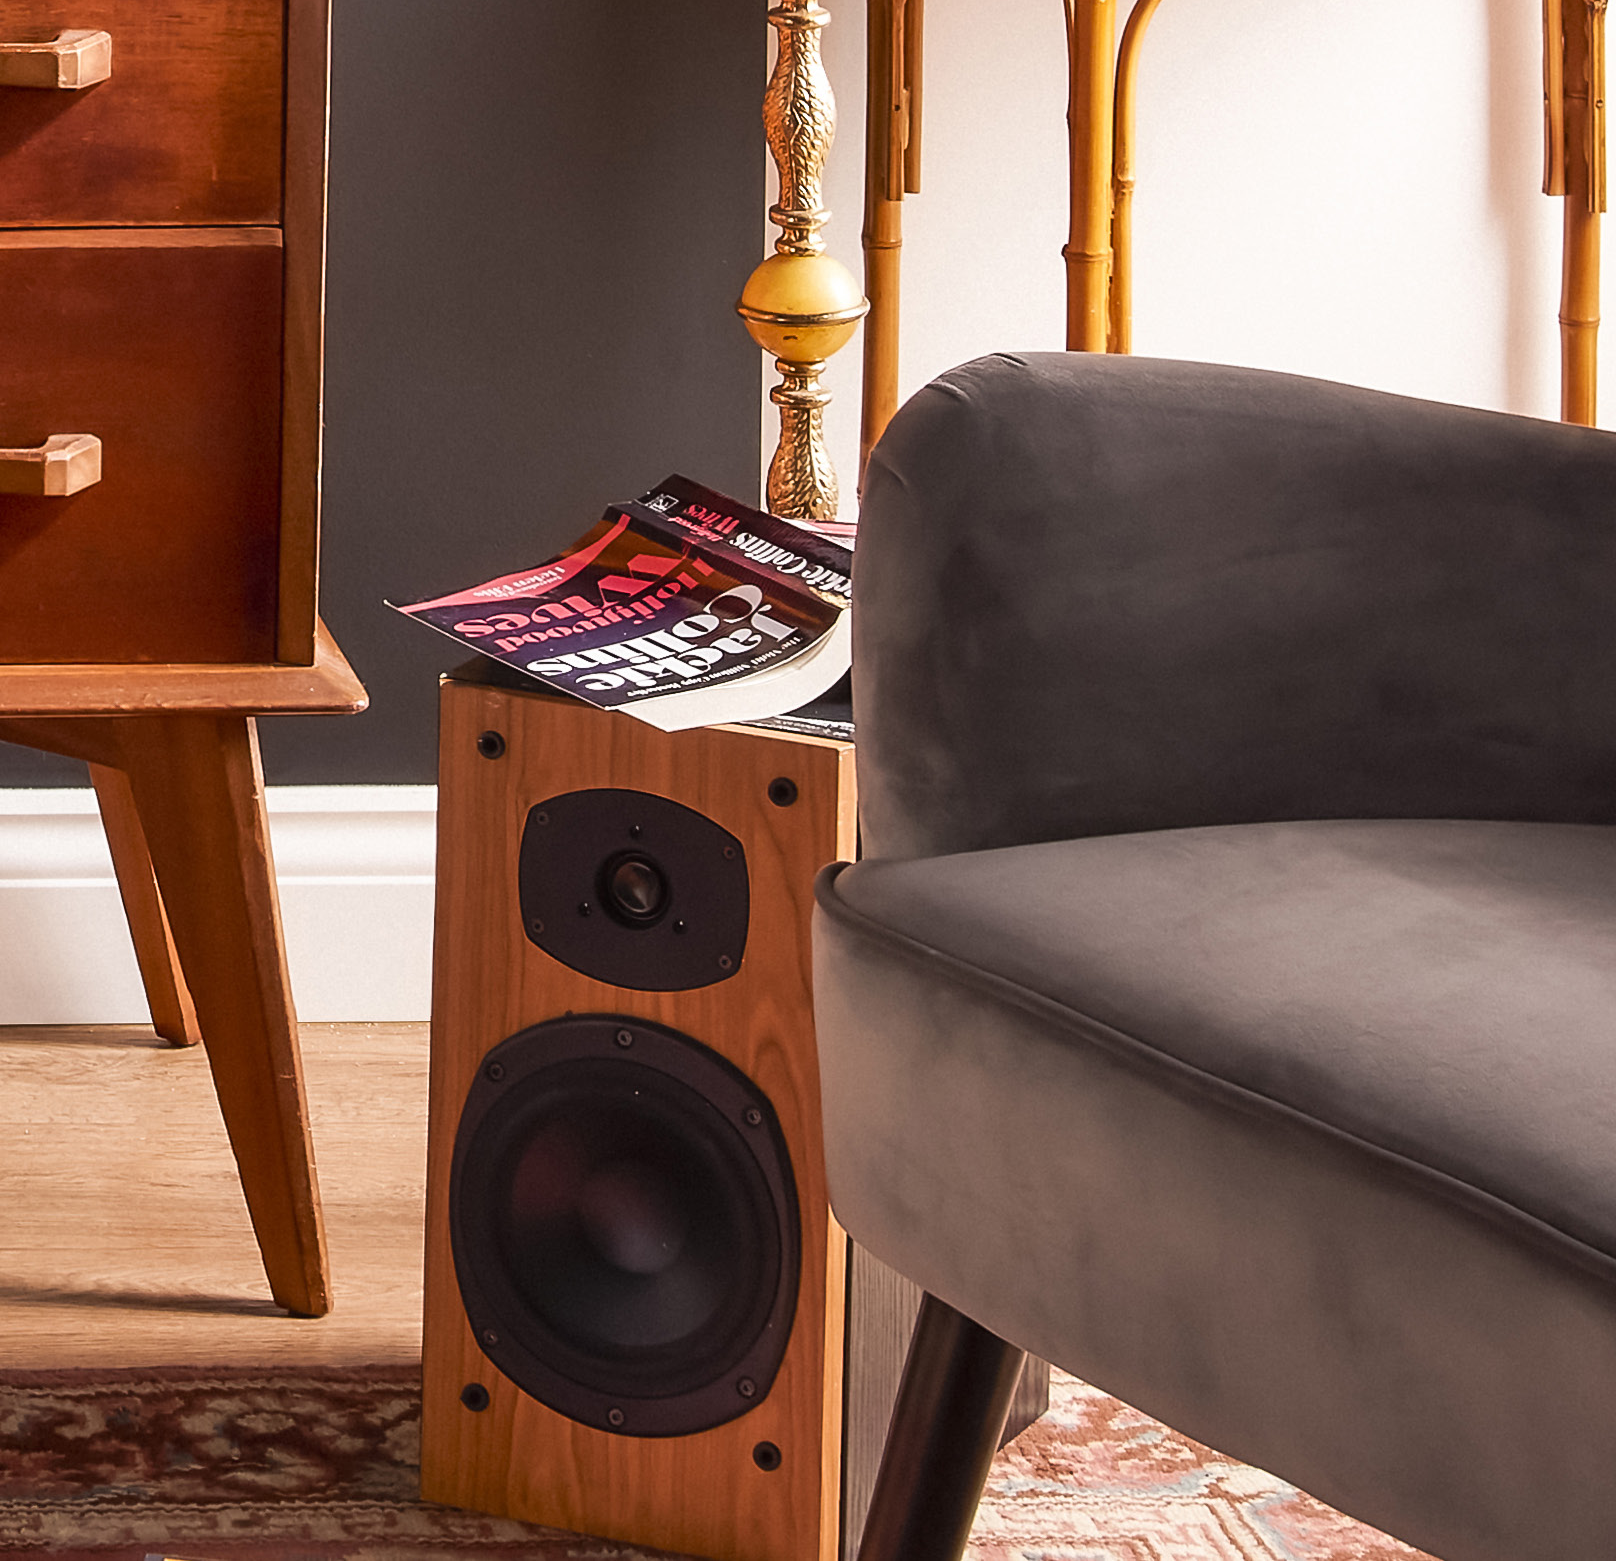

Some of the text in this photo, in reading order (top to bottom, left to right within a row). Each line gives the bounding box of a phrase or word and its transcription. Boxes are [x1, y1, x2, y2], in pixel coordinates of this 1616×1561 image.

[453, 552, 685, 638] Wives
[493, 557, 714, 655] Hollywood
[526, 583, 763, 676] Collins
[575, 602, 798, 691] Jackie
